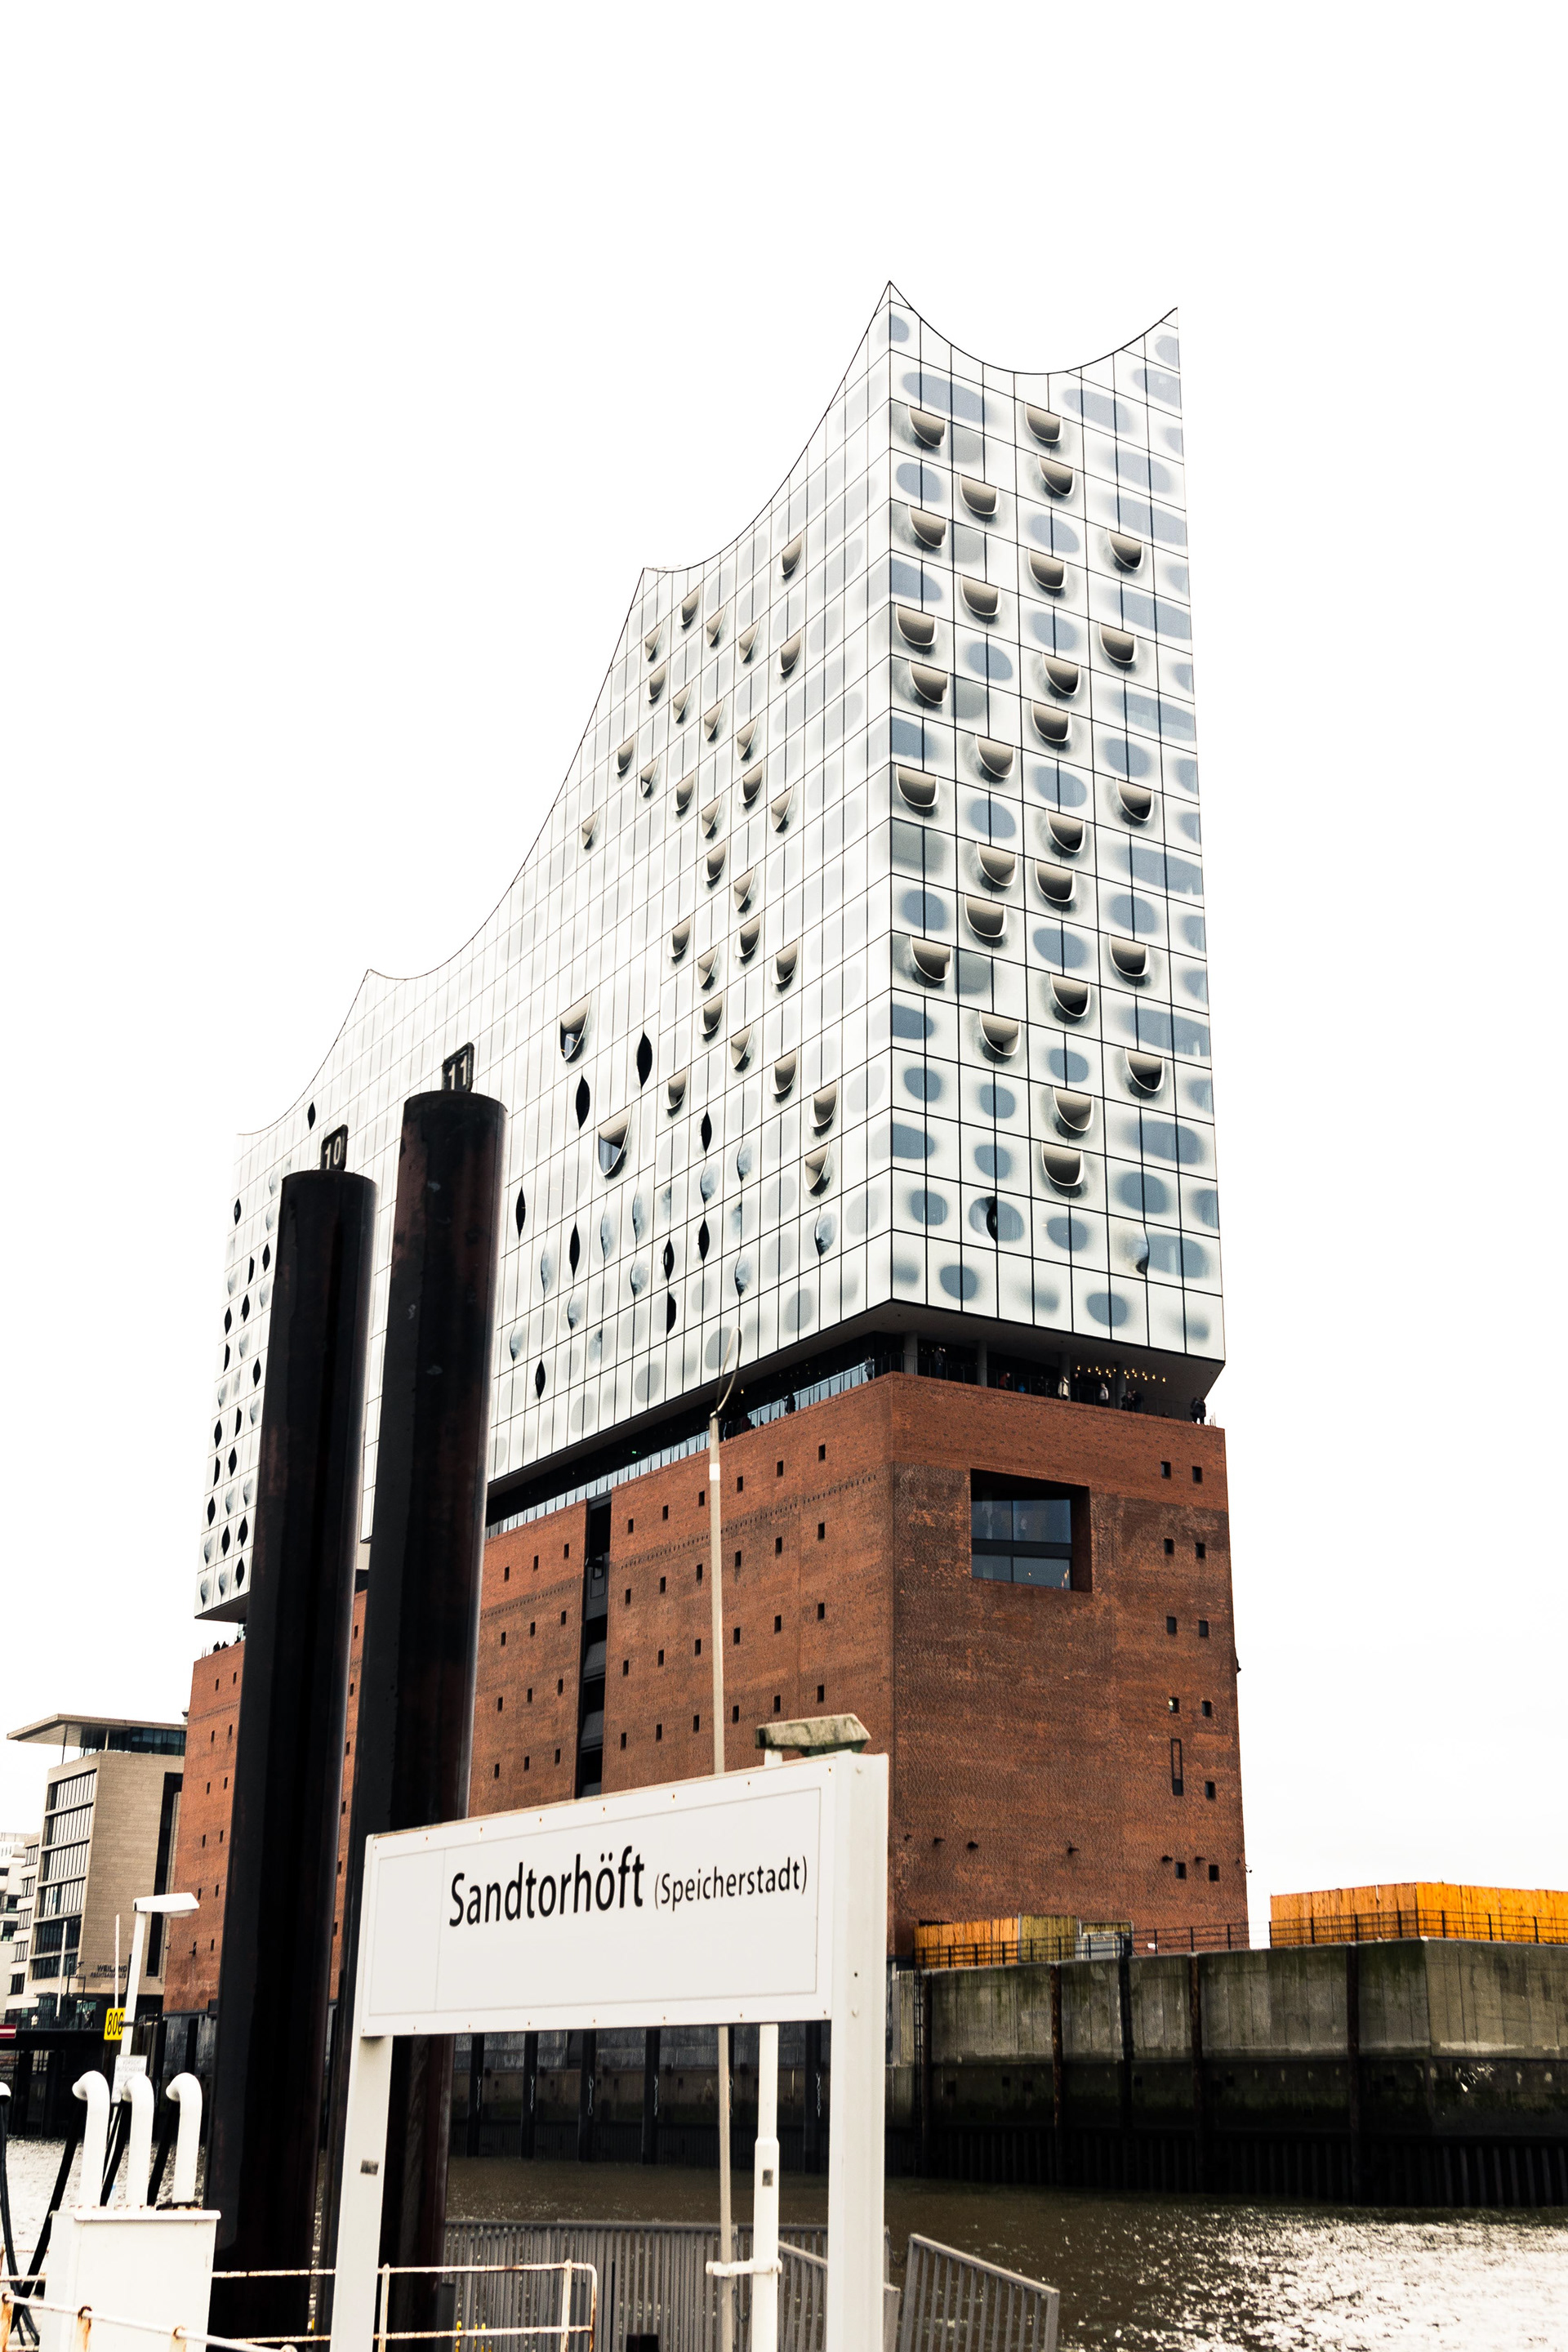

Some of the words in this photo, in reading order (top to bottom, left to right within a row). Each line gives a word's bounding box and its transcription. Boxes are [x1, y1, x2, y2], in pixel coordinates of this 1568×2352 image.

[448, 1054, 467, 1090] 11
[324, 1136, 341, 1169] 10
[448, 1845, 645, 1927] Sandtorhöft
[654, 1855, 808, 1912] (Speicherstadt)
